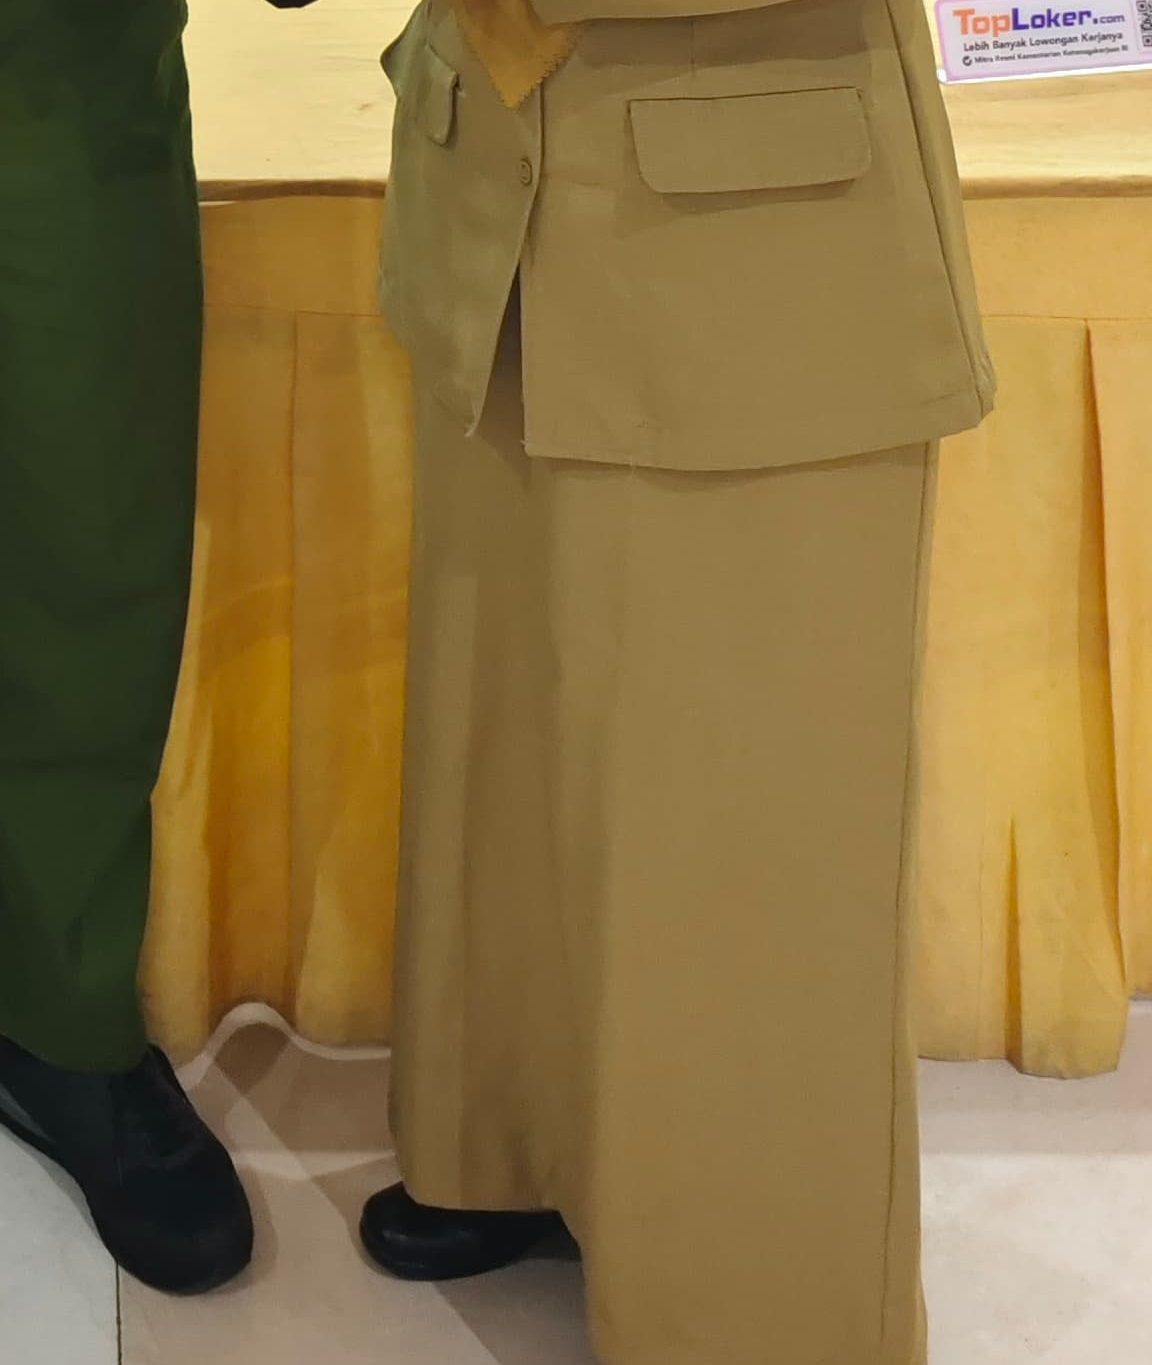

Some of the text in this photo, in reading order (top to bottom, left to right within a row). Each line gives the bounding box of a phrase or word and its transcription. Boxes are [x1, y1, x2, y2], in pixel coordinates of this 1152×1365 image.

[953, 7, 1126, 37] TopLoker.com
[964, 31, 1123, 52] Lebih Banyak Lowongan Kerjanya
